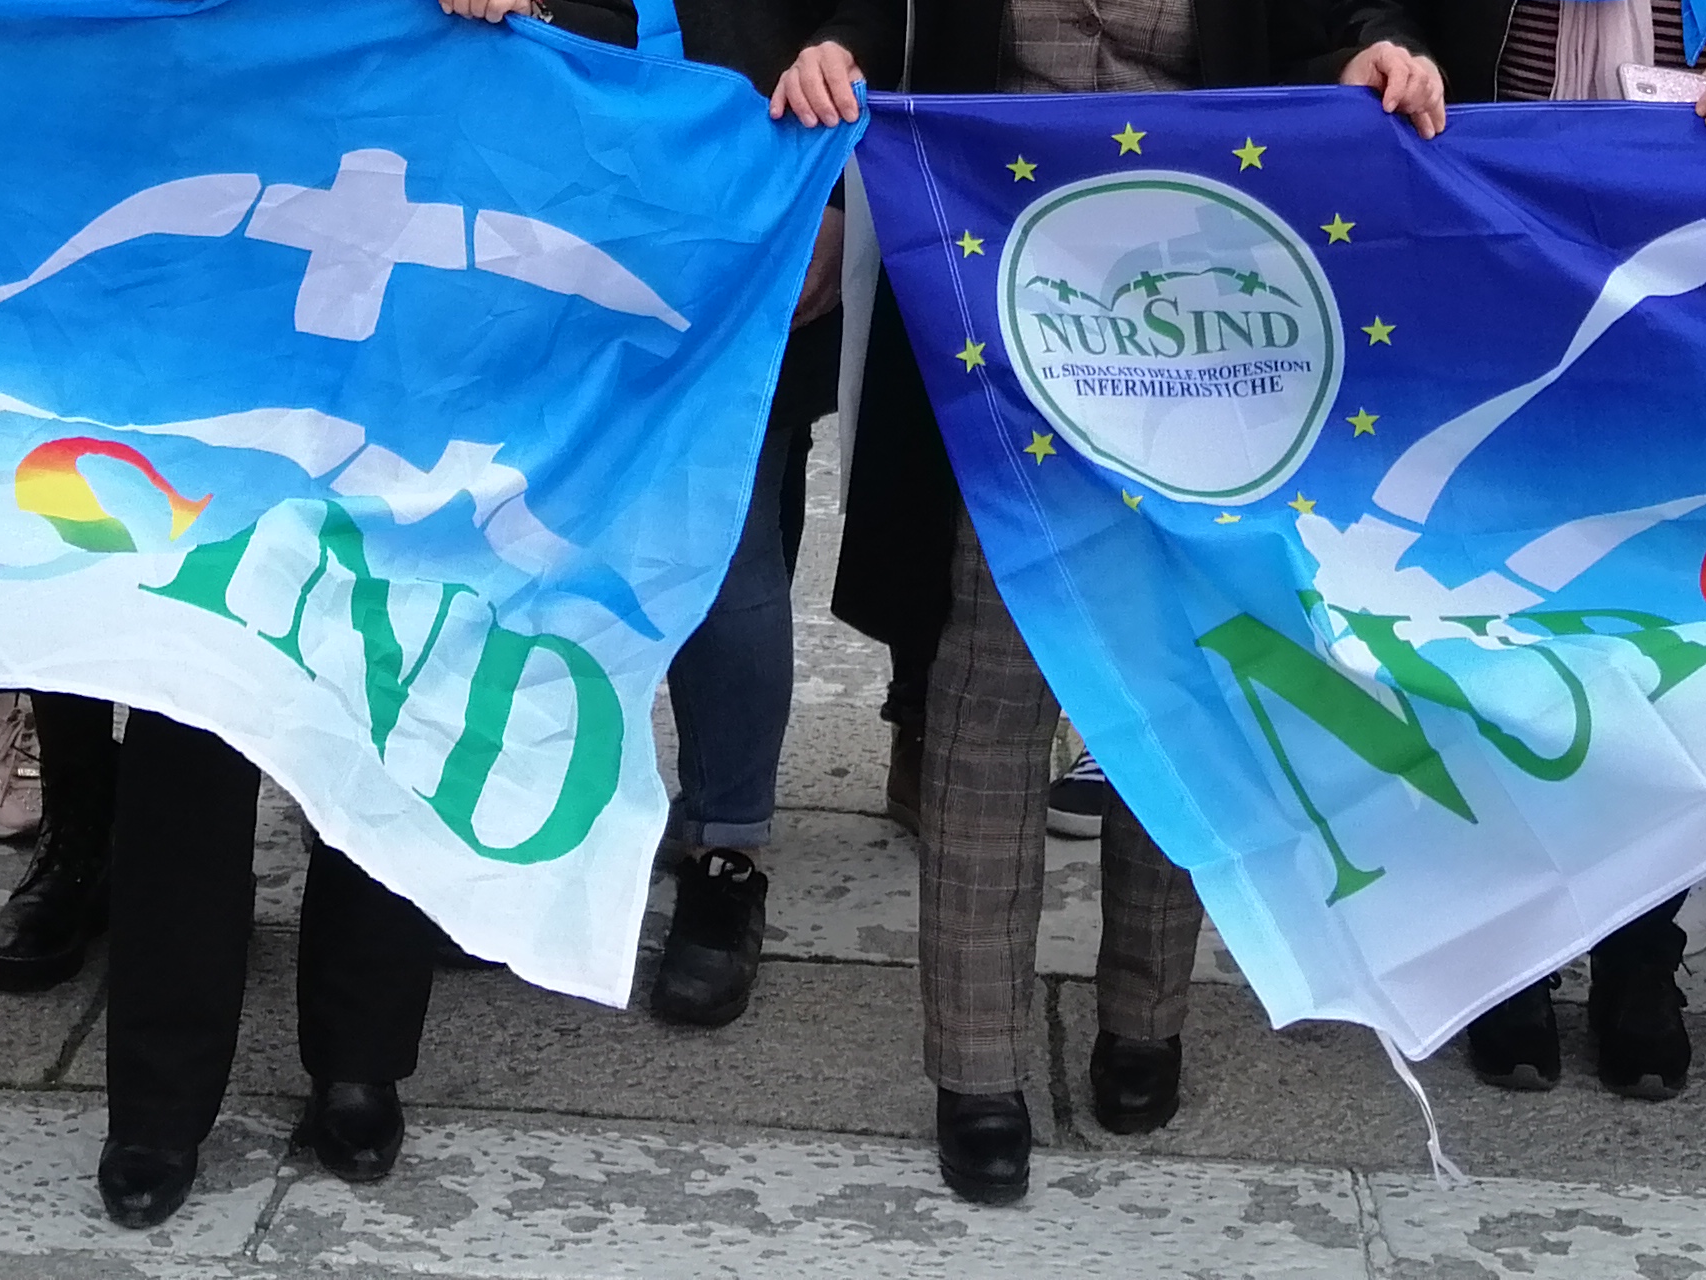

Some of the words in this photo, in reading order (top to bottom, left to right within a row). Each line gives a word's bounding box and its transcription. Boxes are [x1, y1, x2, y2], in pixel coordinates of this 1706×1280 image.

[1030, 296, 1300, 360] NURSIND
[1041, 366, 1061, 380] IL
[1061, 364, 1146, 379] SINDACATO
[1147, 367, 1197, 381] DELLE
[1197, 359, 1312, 382] PROFESSIONI
[1074, 375, 1285, 398] INFERMIERISTICHE
